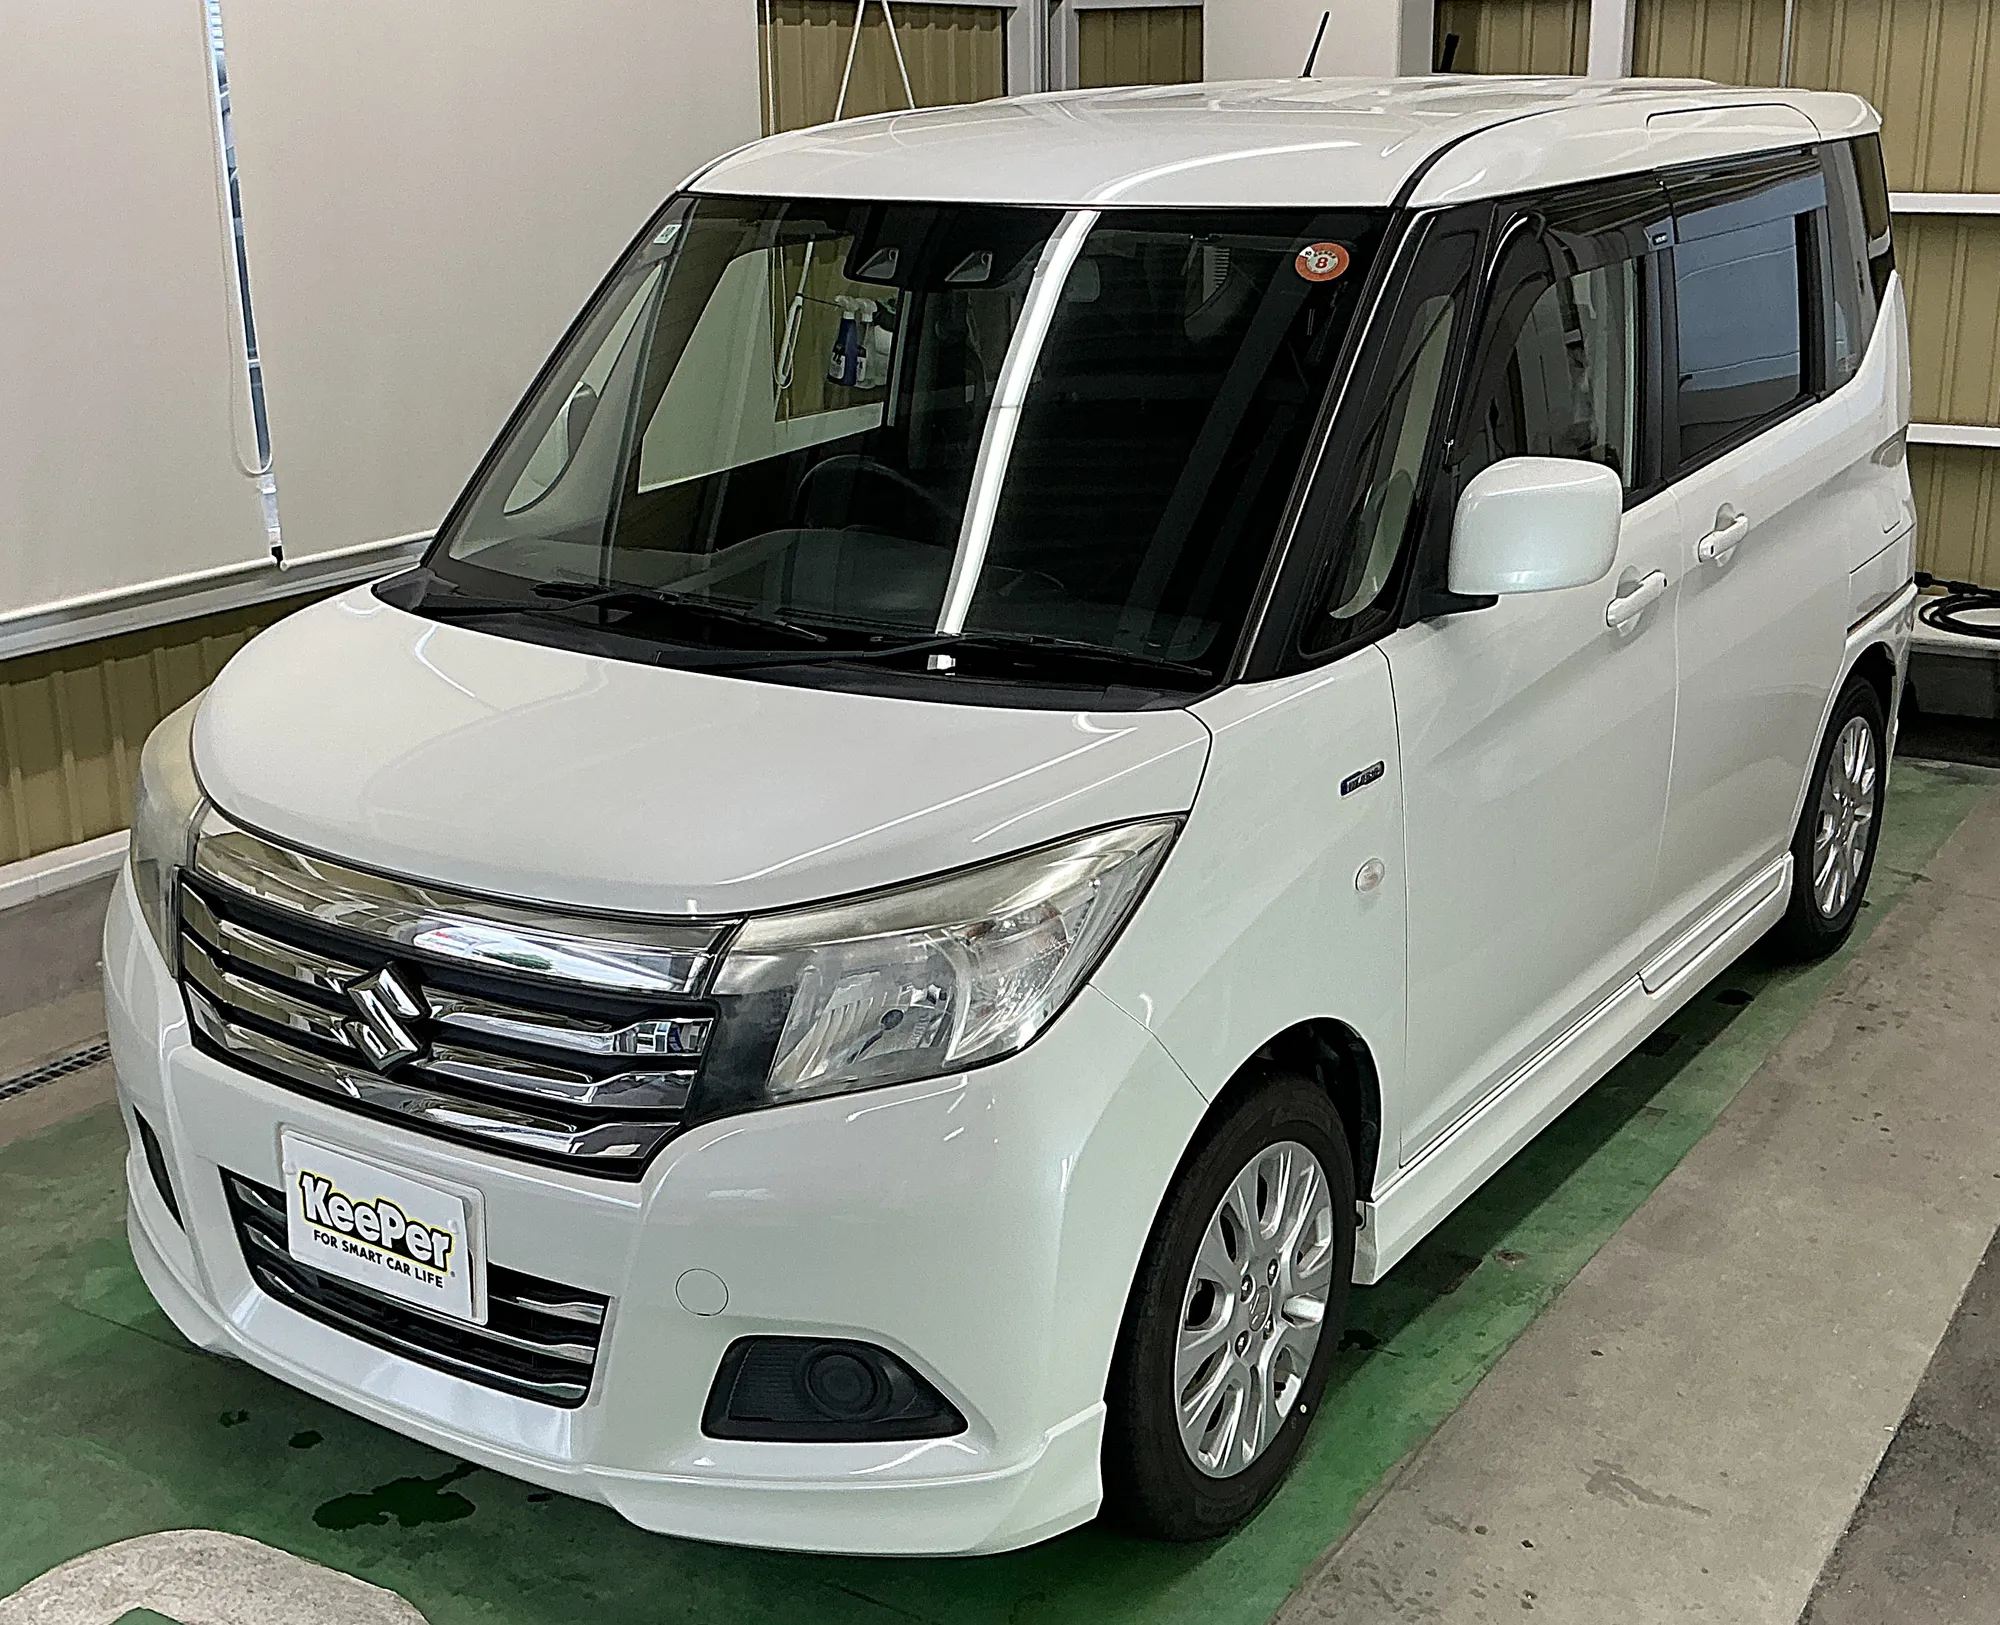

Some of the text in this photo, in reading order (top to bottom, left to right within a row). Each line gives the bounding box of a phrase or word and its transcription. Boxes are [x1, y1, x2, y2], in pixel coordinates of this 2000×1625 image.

[1315, 257, 1329, 269] 8
[299, 1171, 452, 1272] KeePer
[313, 1229, 443, 1289] FOR SMART CAR LIFE
